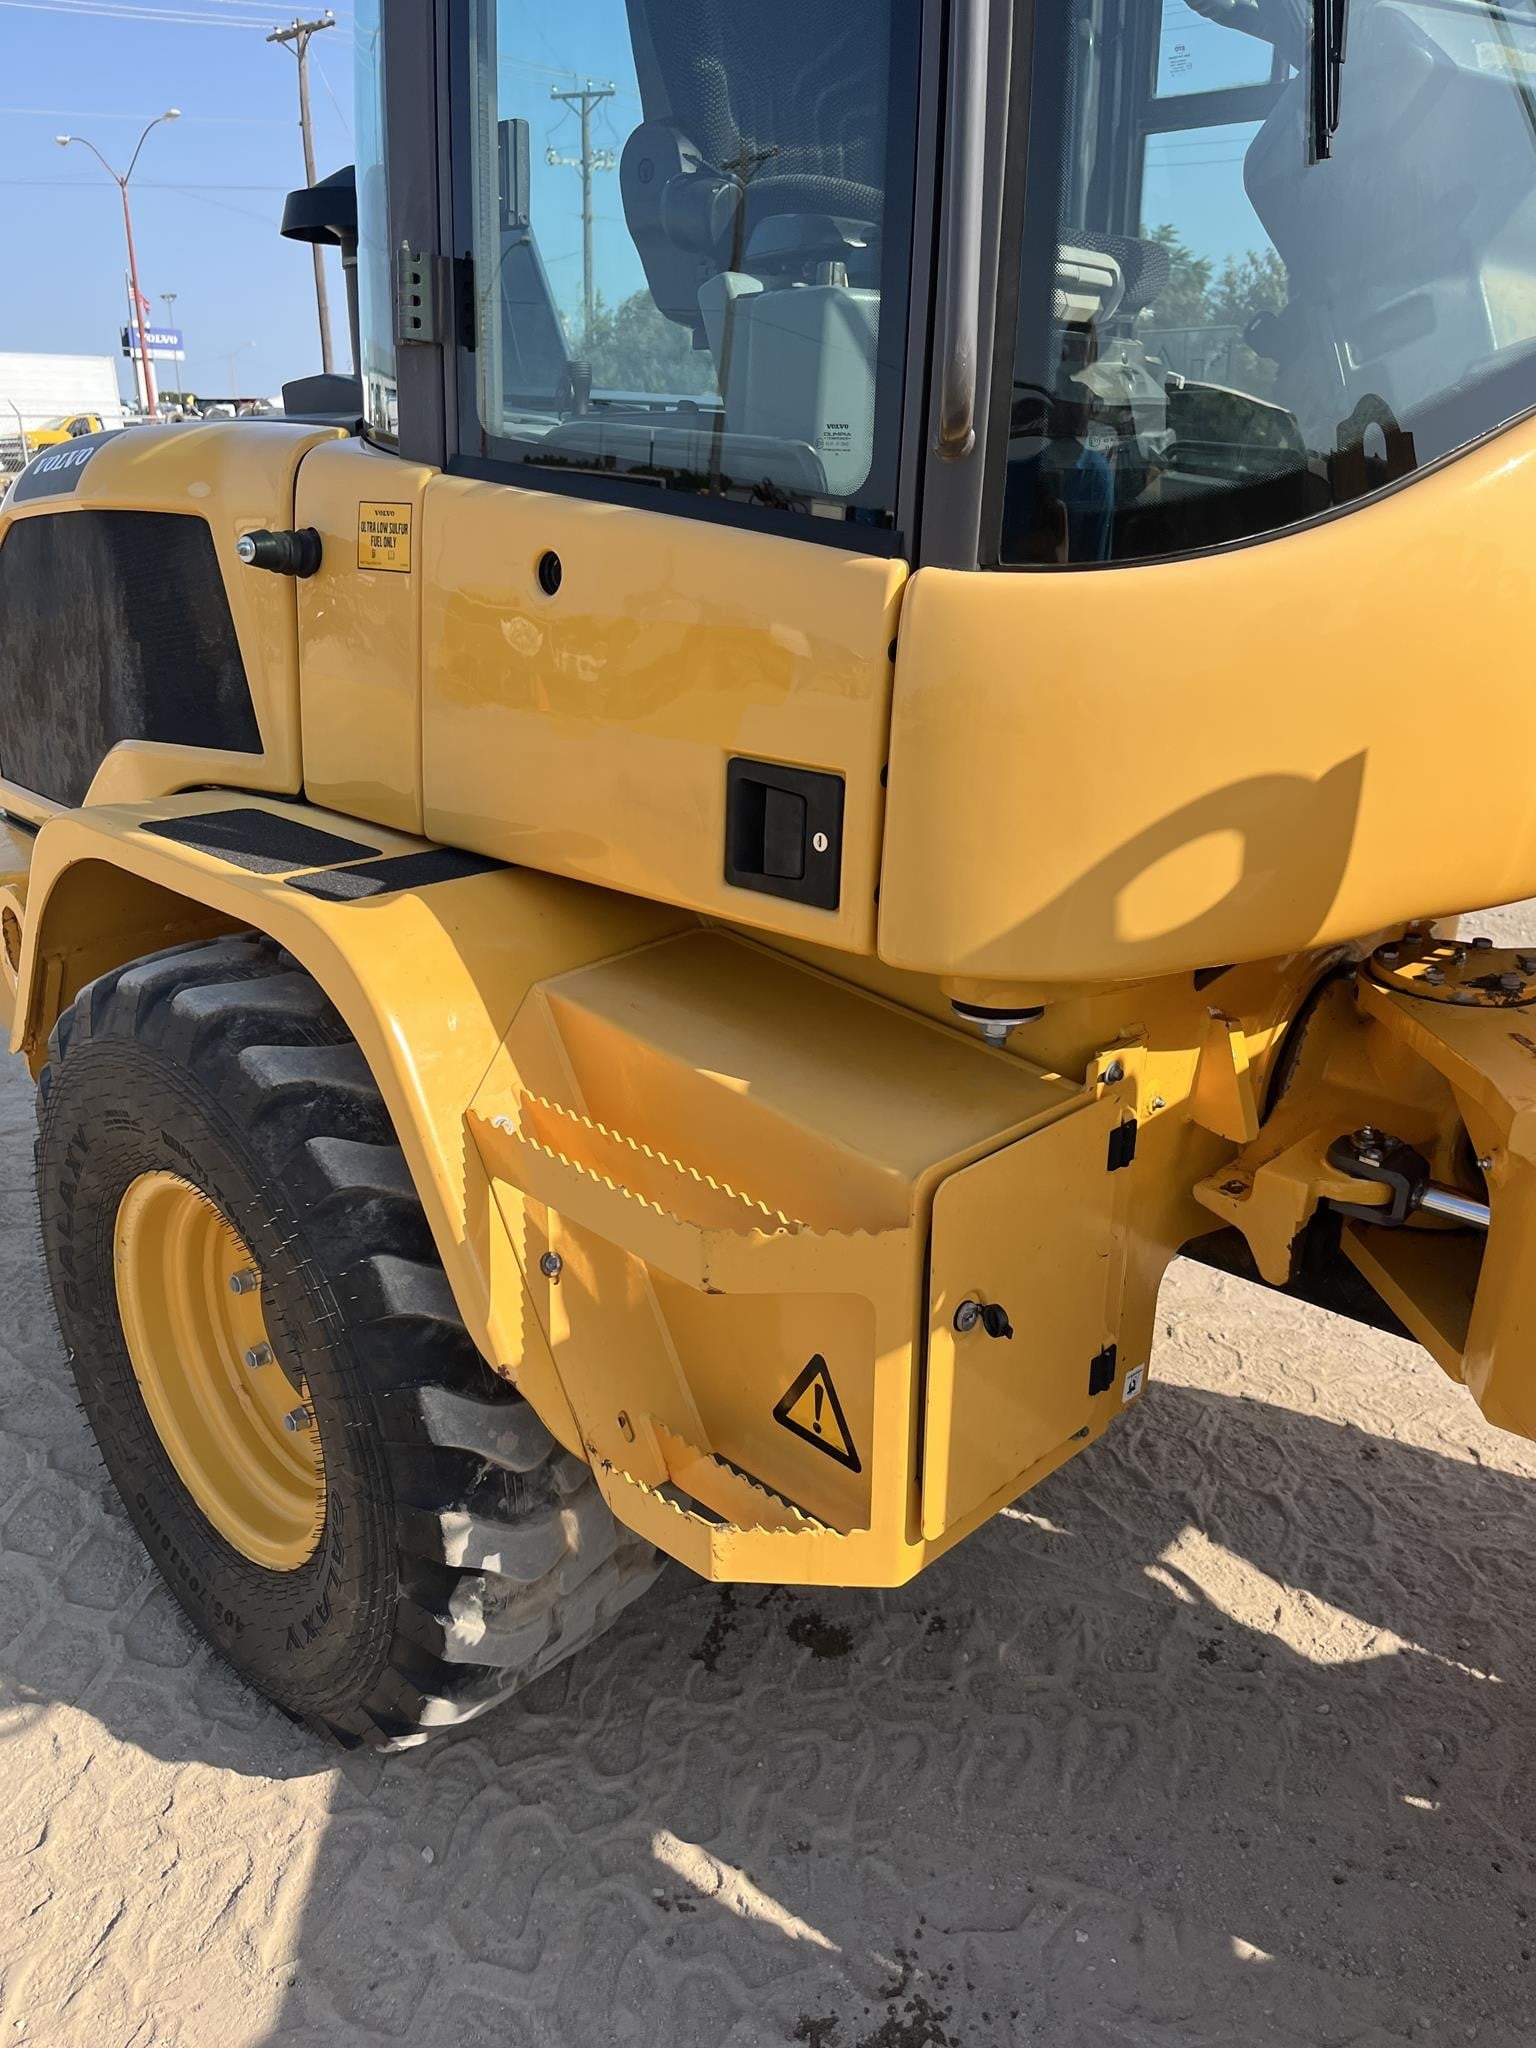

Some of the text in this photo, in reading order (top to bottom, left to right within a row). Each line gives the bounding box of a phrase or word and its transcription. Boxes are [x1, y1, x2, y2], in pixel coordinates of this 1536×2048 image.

[33, 447, 94, 475] VOLVO
[361, 521, 408, 535] ULTRA LOW SULFUR
[370, 536, 397, 548] FUEL ONLY
[57, 1124, 91, 1312] GALAXY
[286, 1488, 345, 1653] GALAXY
